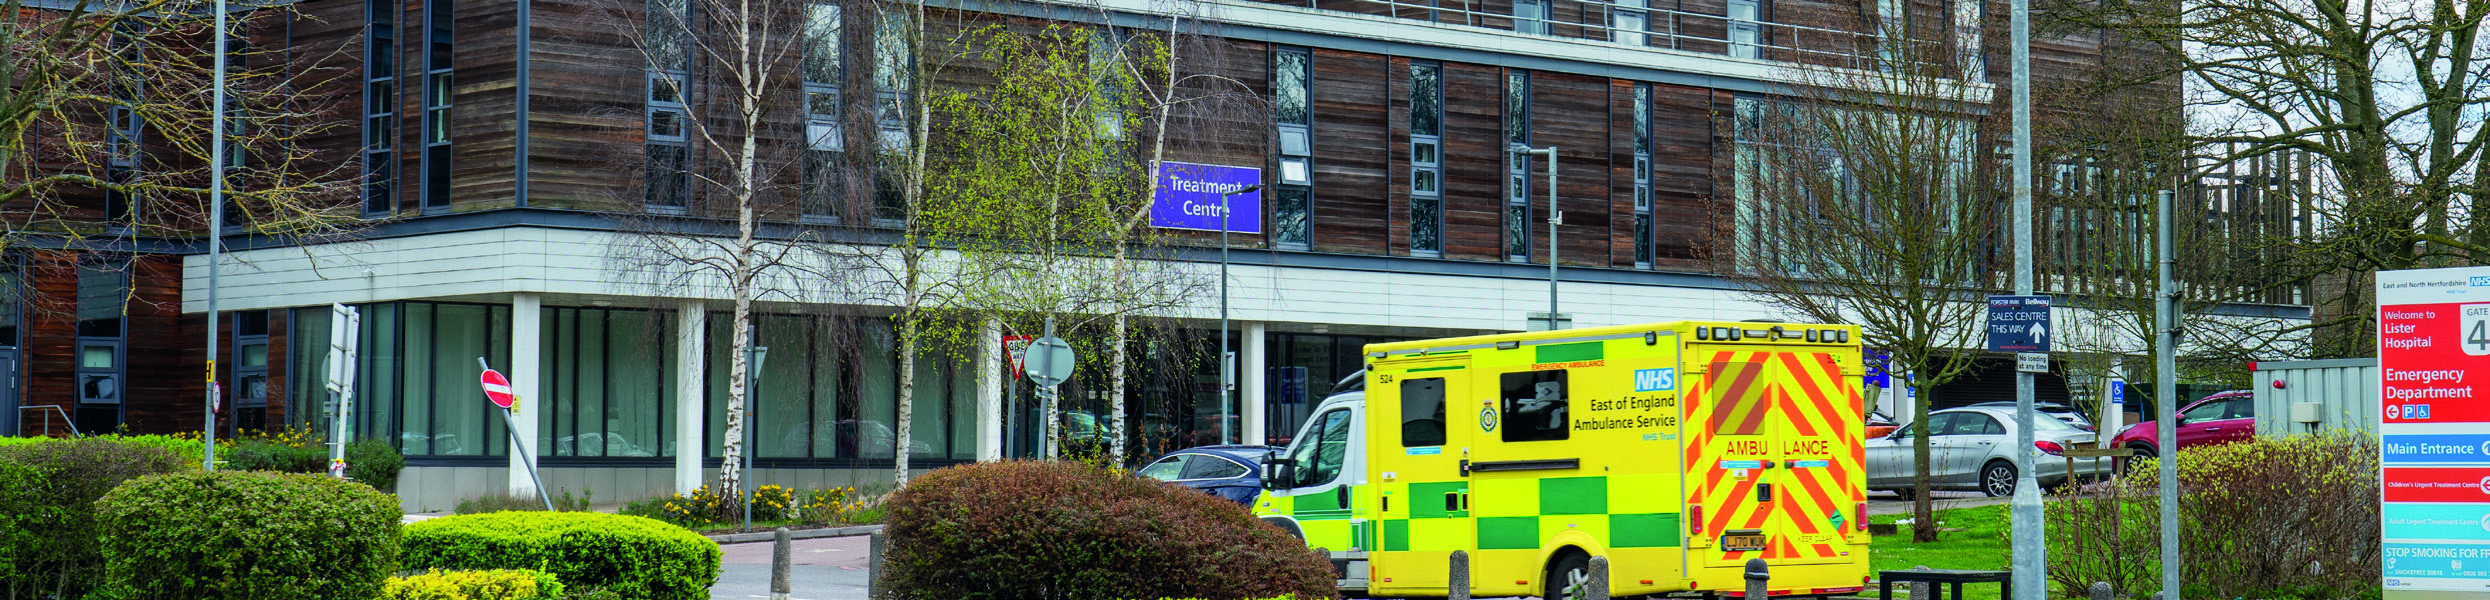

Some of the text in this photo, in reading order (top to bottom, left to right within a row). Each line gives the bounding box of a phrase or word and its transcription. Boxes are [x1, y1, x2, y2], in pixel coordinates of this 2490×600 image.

[1170, 174, 1242, 196] Treatment
[2470, 276, 2490, 286] NHS
[2025, 298, 2049, 306] Bellway
[1992, 312, 2046, 320] SALES CENTRE
[2385, 311, 2424, 320] Welcome
[2467, 308, 2488, 316] GATE
[1992, 325, 2025, 333] THIS WAY
[2385, 323, 2416, 334] Lister
[2468, 320, 2490, 350] 4
[2385, 336, 2431, 350] Hospital
[1568, 360, 1605, 368] AMBULANCE
[1380, 374, 1393, 384] 524
[1636, 368, 1674, 392] NHS
[2386, 368, 2464, 384] Emergency
[2386, 386, 2472, 402] Department
[1592, 394, 1675, 411] East of England
[1574, 414, 1675, 430] Ambulance Service
[1726, 440, 1828, 456] AMBU LANCE
[2387, 443, 2474, 454] Main Entrance
[2386, 548, 2410, 557] STOP
[2412, 548, 2457, 558] SMOKING
[2460, 548, 2478, 558] FOR
